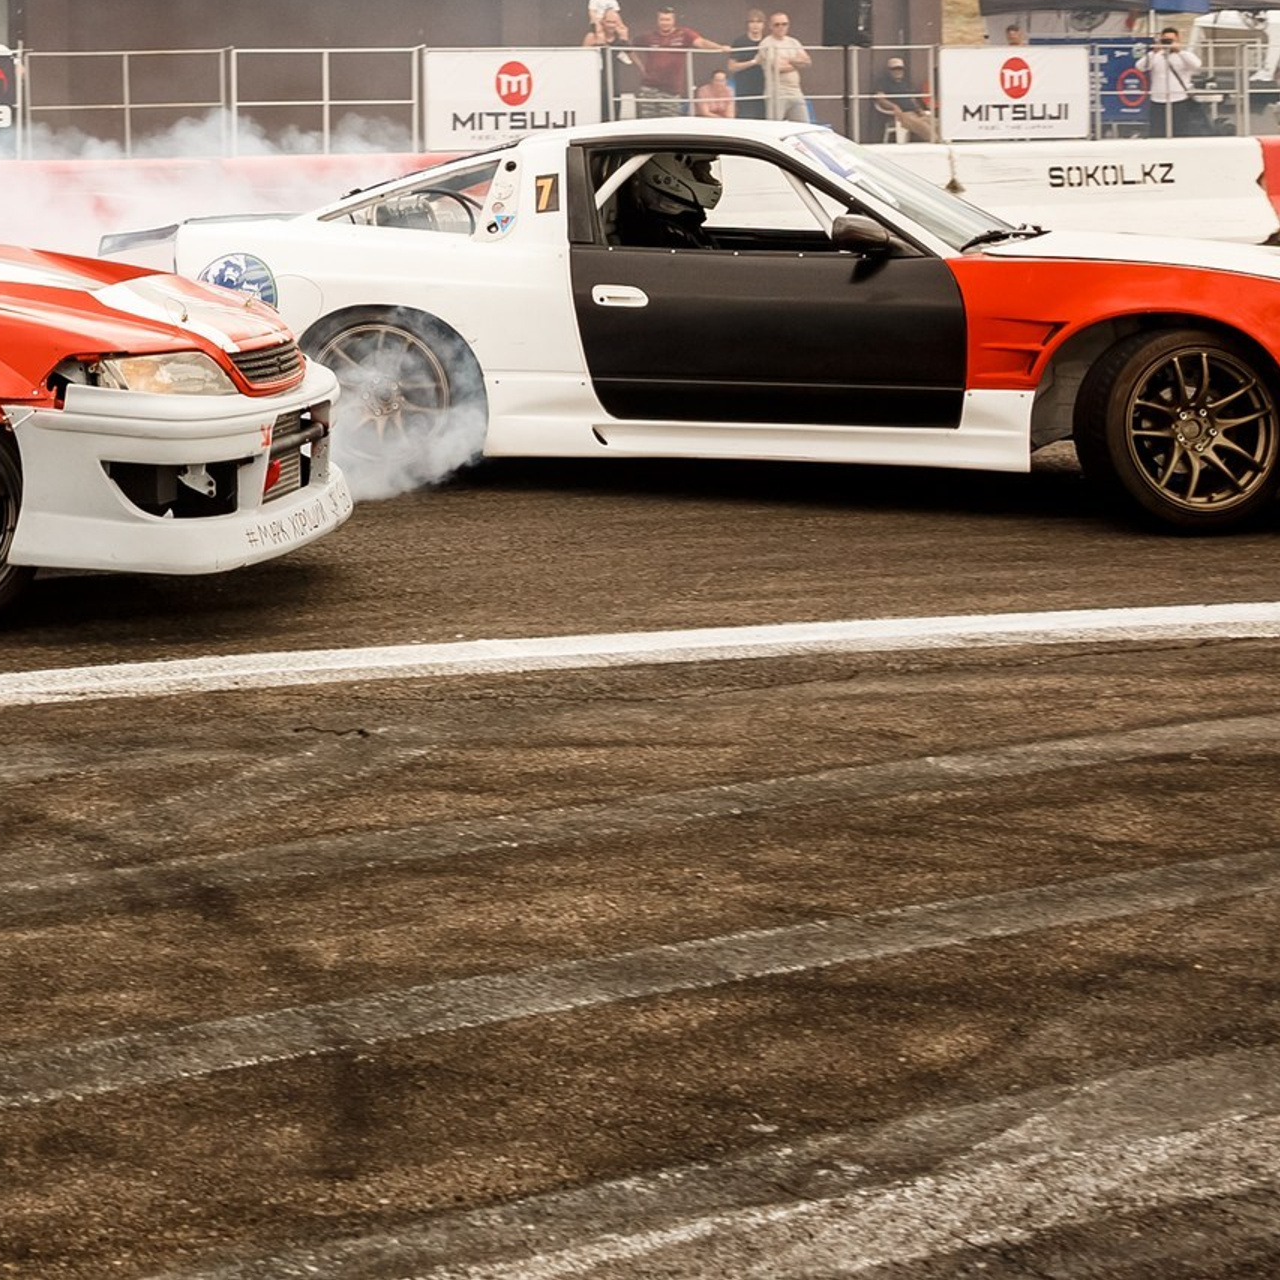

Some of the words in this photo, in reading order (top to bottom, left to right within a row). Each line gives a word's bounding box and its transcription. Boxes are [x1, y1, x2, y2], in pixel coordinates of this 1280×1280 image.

[452, 111, 576, 131] MITSUJI
[962, 104, 1068, 121] MITSUJI
[1048, 163, 1175, 187] SOKOL.KZ
[536, 177, 554, 211] 7
